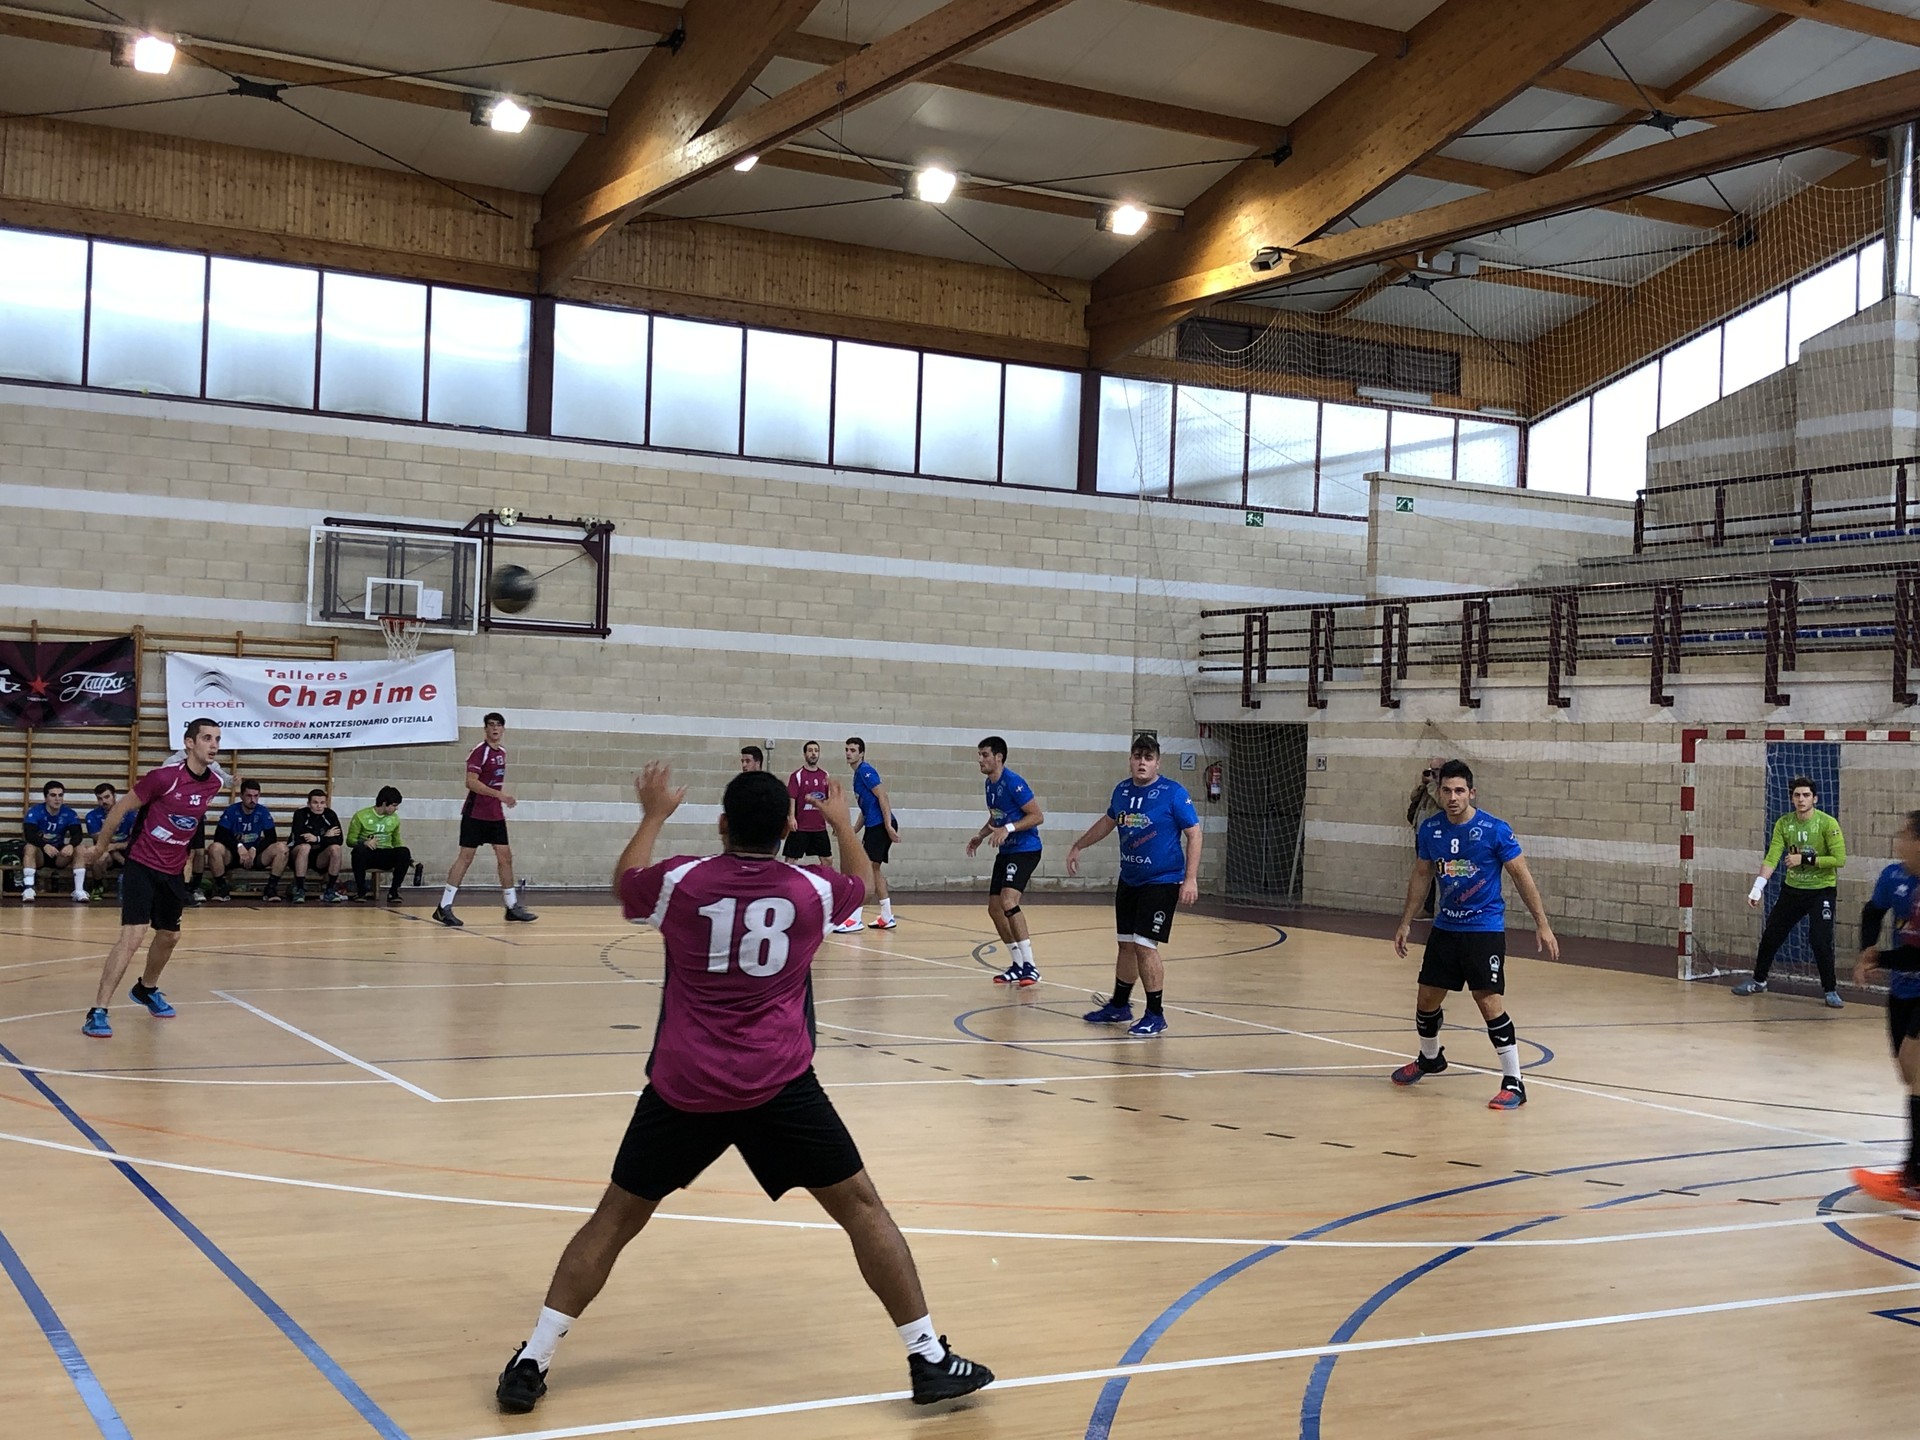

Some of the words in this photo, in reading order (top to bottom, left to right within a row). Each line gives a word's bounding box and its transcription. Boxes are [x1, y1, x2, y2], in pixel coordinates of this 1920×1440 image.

[265, 669, 348, 681] Talleres
[267, 682, 437, 710] Chapime
[263, 720, 306, 728] CITROËN
[309, 717, 389, 728] KONTZESIONARIO
[392, 715, 433, 723] OFIZIALA
[303, 731, 352, 740] ARRASATE
[189, 794, 202, 806] 15
[1129, 796, 1144, 809] 11
[1798, 831, 1808, 841] 16
[1450, 838, 1460, 854] 8
[698, 897, 796, 977] 18
